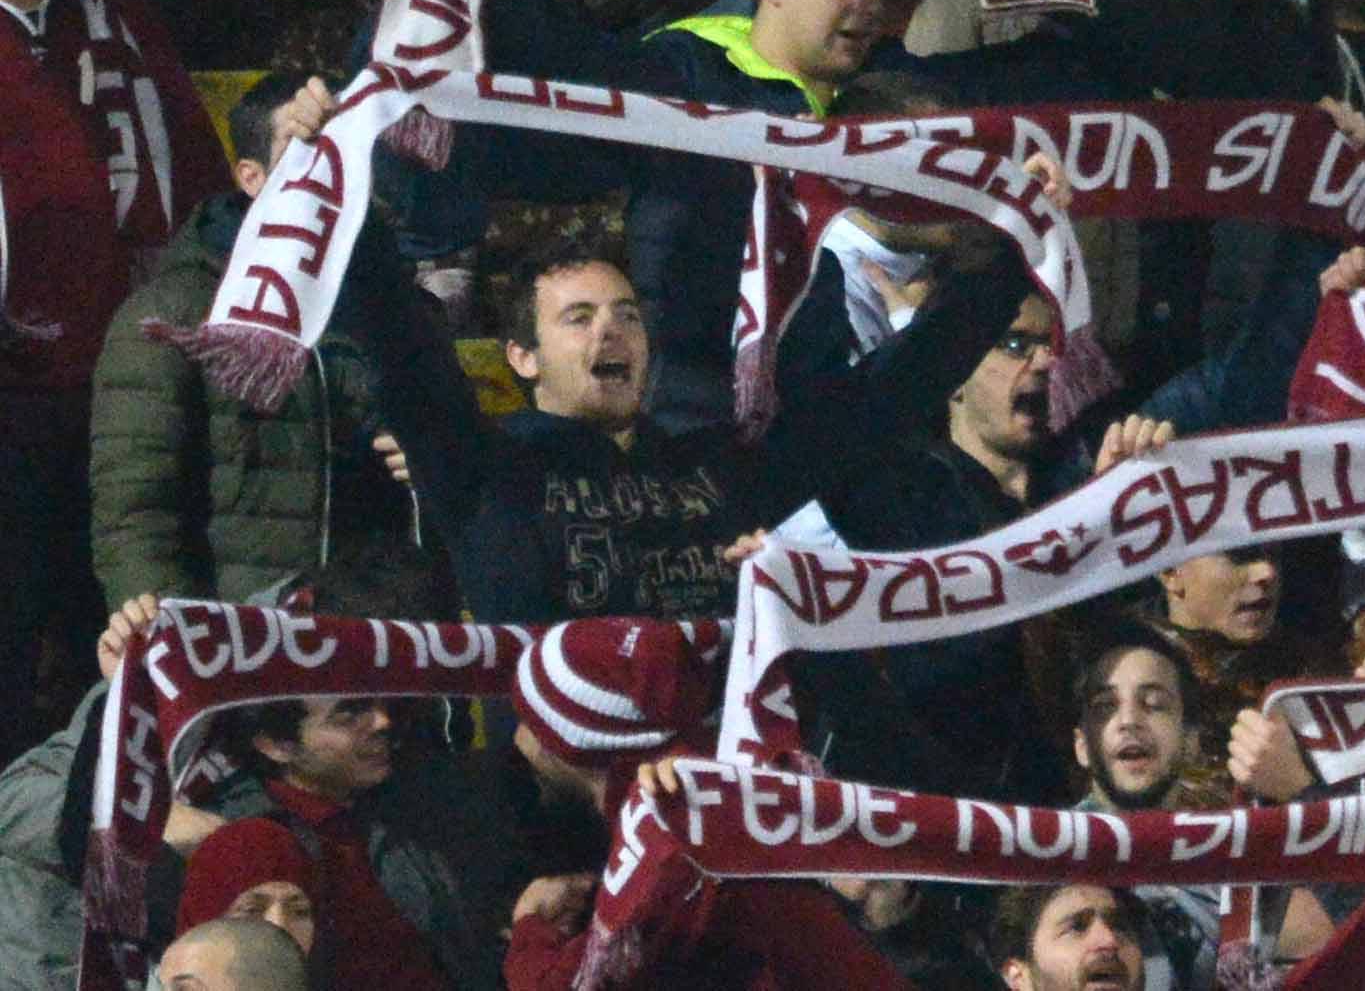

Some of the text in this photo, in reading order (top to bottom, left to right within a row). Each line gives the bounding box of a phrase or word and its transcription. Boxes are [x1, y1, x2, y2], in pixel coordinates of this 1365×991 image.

[1206, 113, 1295, 194] SI
[674, 759, 916, 848] FEDE
[956, 796, 1131, 861] NON
